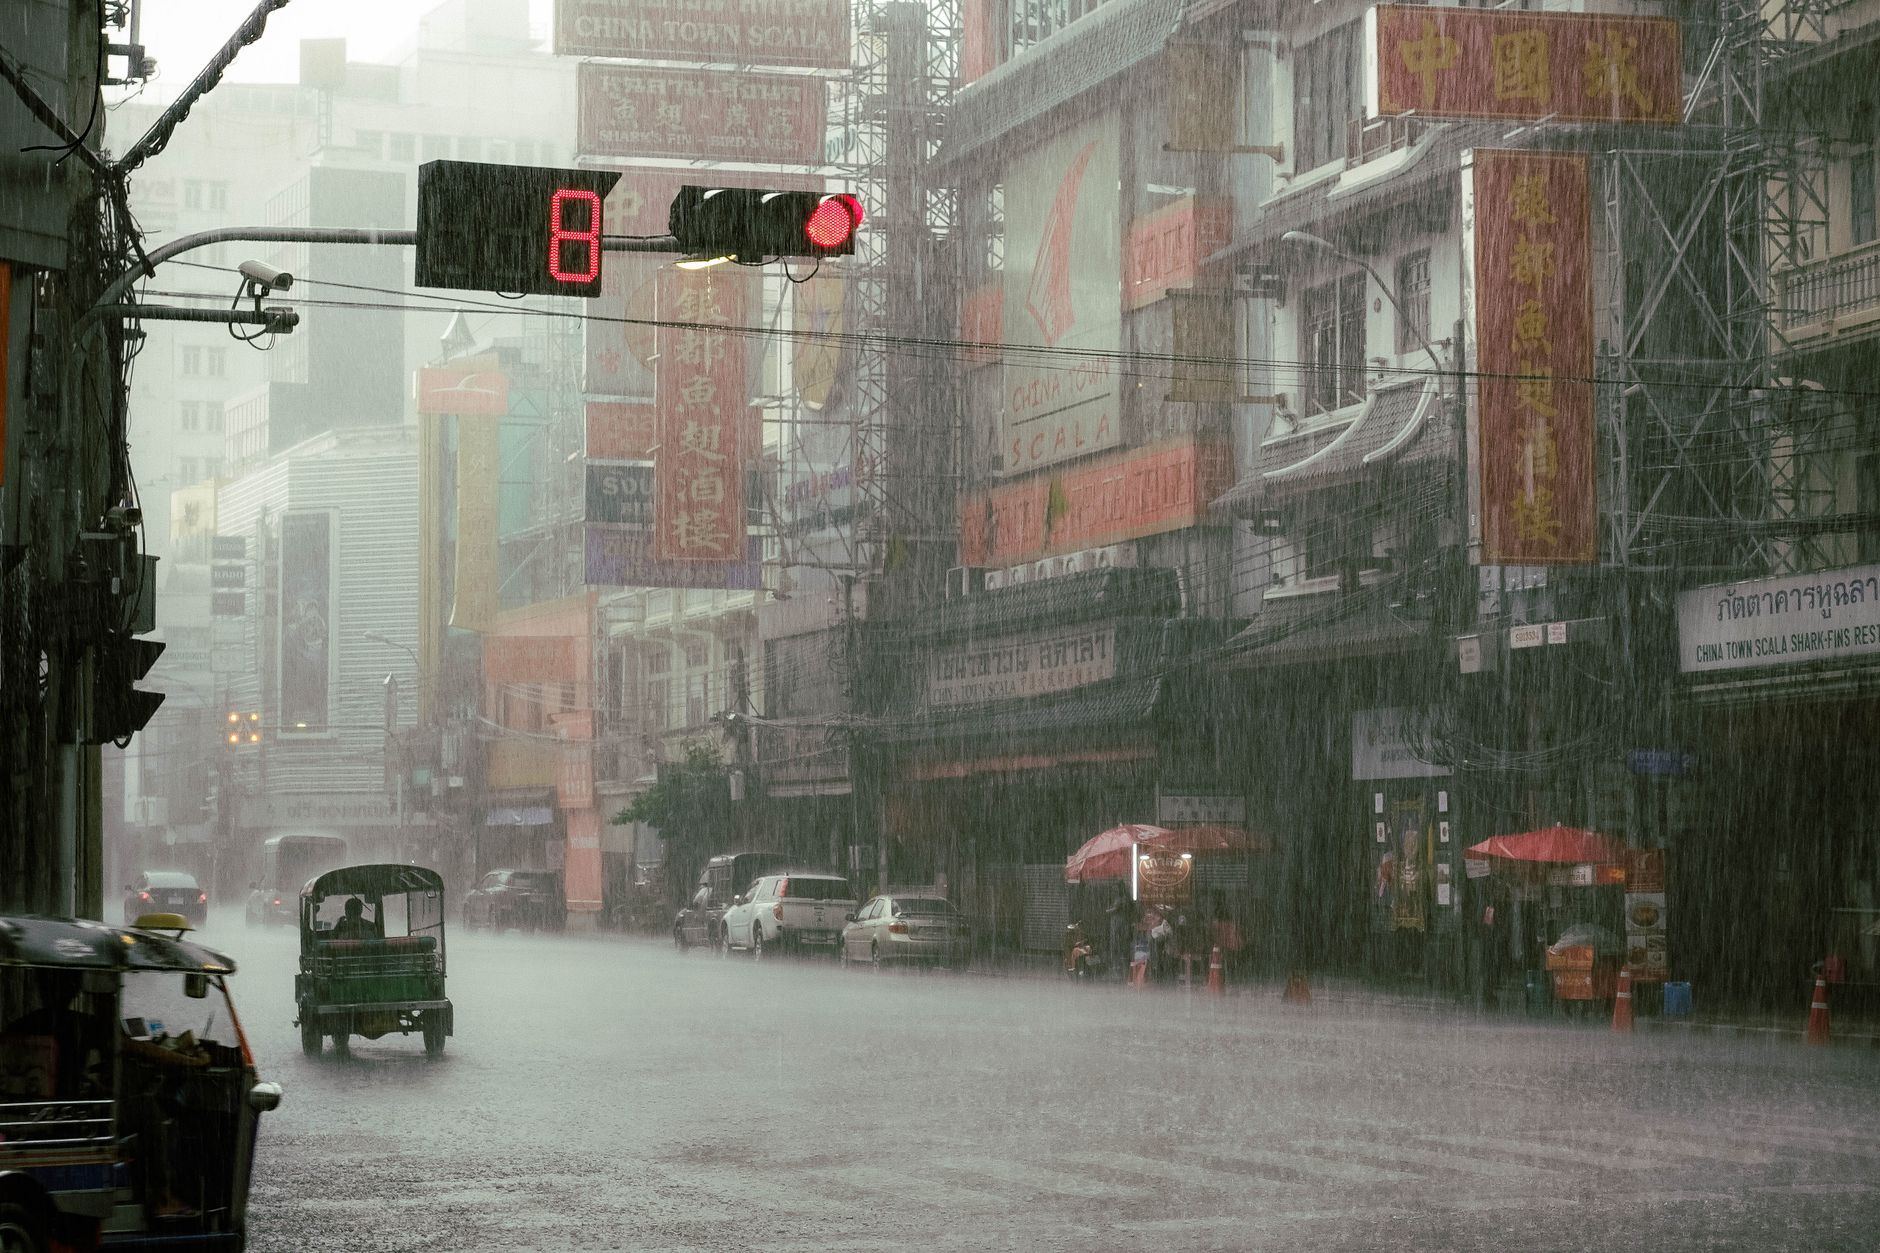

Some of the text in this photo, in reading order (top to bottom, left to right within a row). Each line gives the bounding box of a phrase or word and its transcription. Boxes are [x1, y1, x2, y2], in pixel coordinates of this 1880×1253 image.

[576, 15, 830, 49] CHINA TOWN SCALA
[1398, 17, 1654, 113] 中國城
[666, 132, 692, 146] FIN
[549, 188, 600, 283] 8
[1012, 357, 1111, 414] CHINA TOWN
[672, 287, 730, 551] 銀都魚翅酒樓
[1011, 414, 1110, 467] SCALA
[1696, 644, 1723, 663] CHINA
[1726, 640, 1753, 660] TOWN
[1755, 635, 1787, 657] SCALA
[1791, 630, 1851, 653] SHARK-FINS
